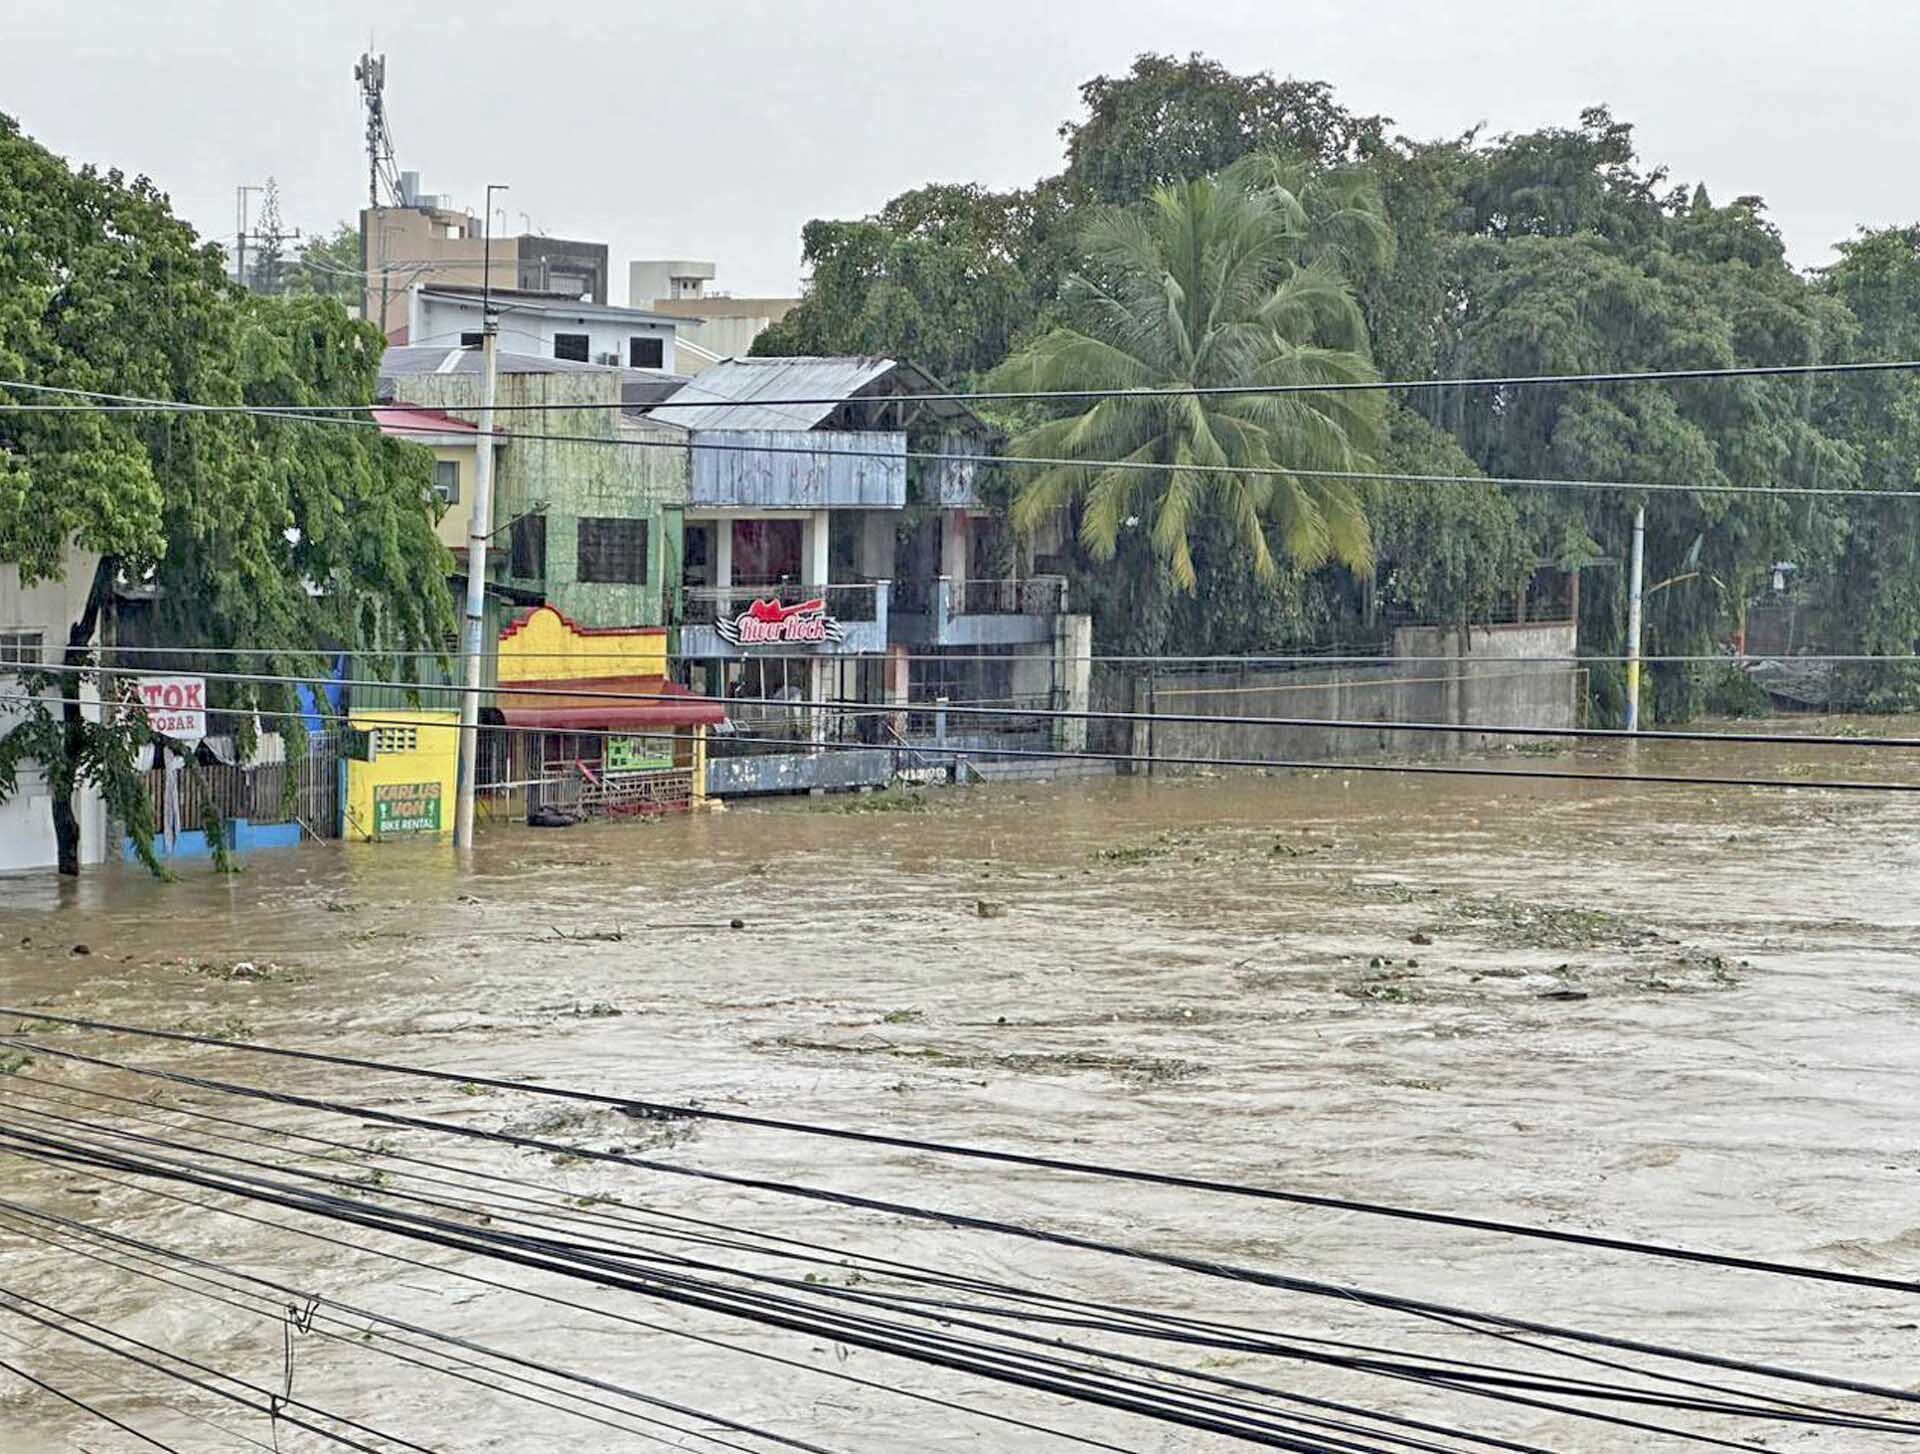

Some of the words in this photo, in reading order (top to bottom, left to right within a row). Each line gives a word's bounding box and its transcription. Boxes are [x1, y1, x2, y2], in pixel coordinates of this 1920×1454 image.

[784, 615, 826, 641] Rock
[129, 684, 203, 712] TOK
[380, 820, 401, 832] BIKE
[401, 818, 434, 831] RENTAL
